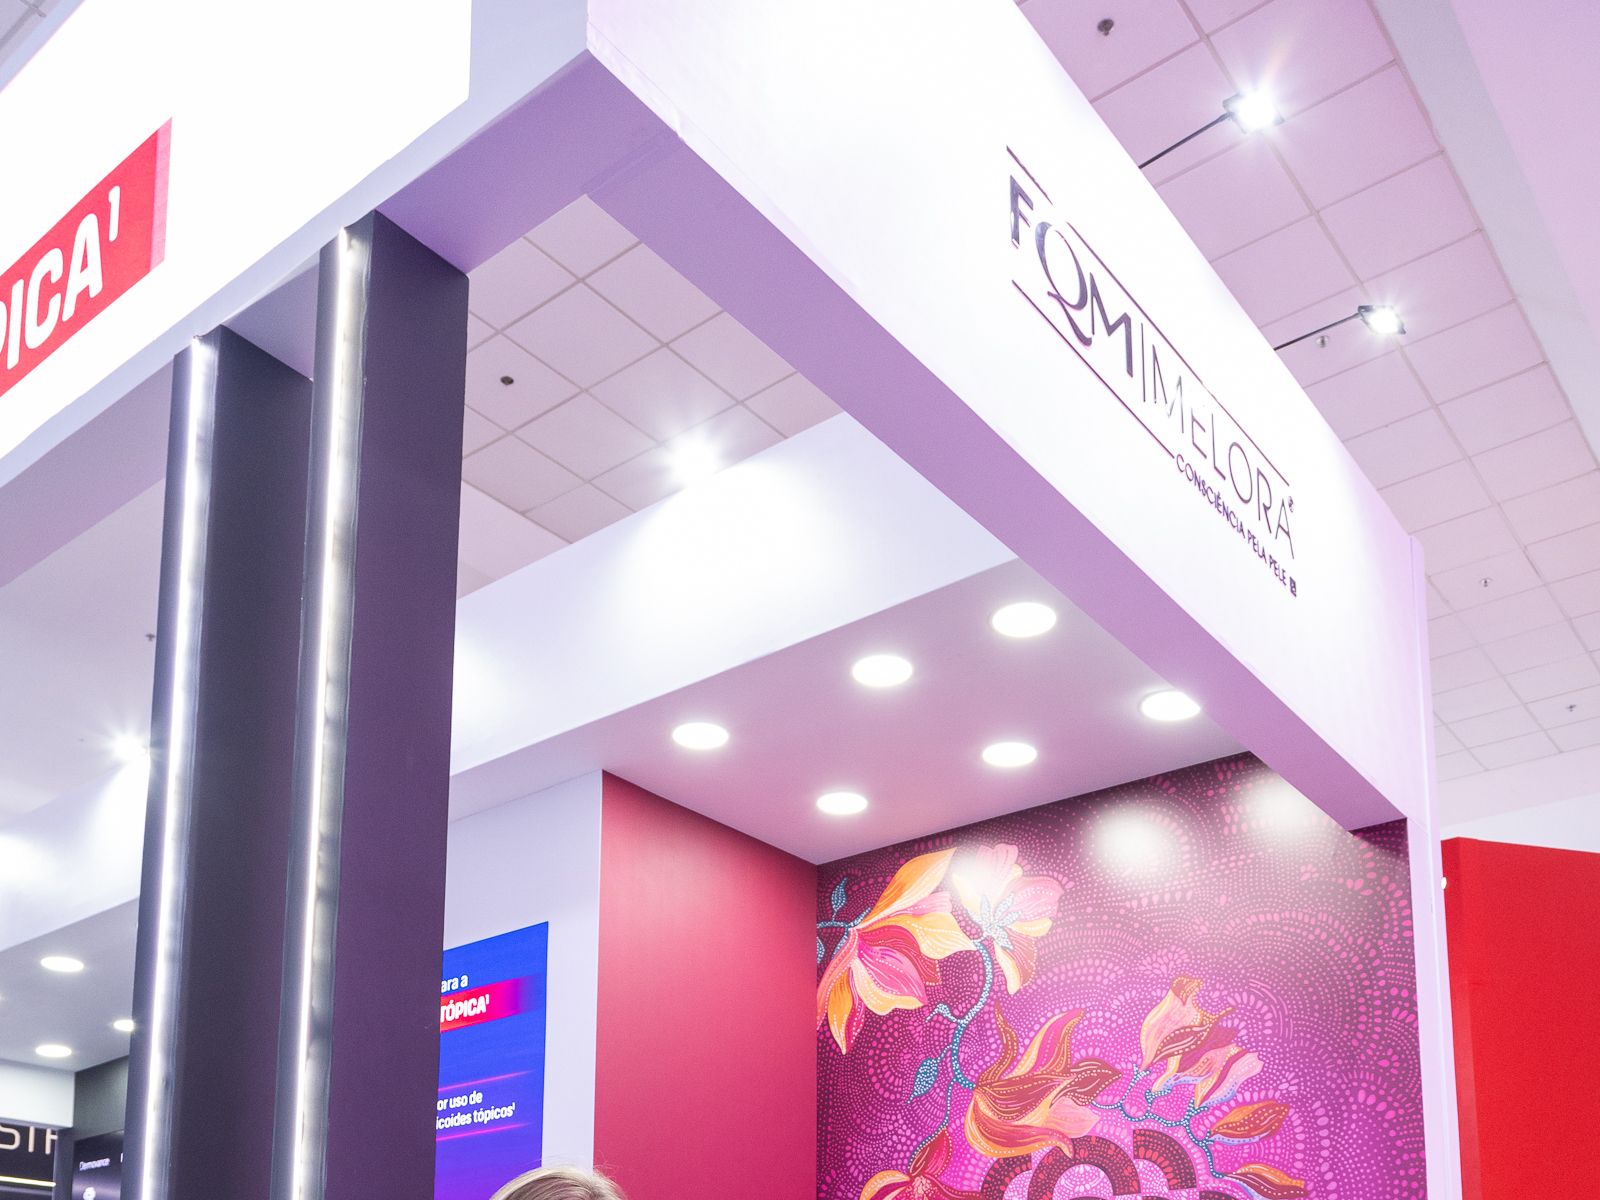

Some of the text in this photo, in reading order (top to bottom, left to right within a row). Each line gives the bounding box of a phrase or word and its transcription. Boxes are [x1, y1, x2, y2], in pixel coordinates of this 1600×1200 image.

[1176, 453, 1287, 586] CONSCIÊNCIA PELA PELE
[441, 974, 468, 993] ara a
[437, 1090, 483, 1111] or uso de
[436, 1112, 472, 1130] icoides
